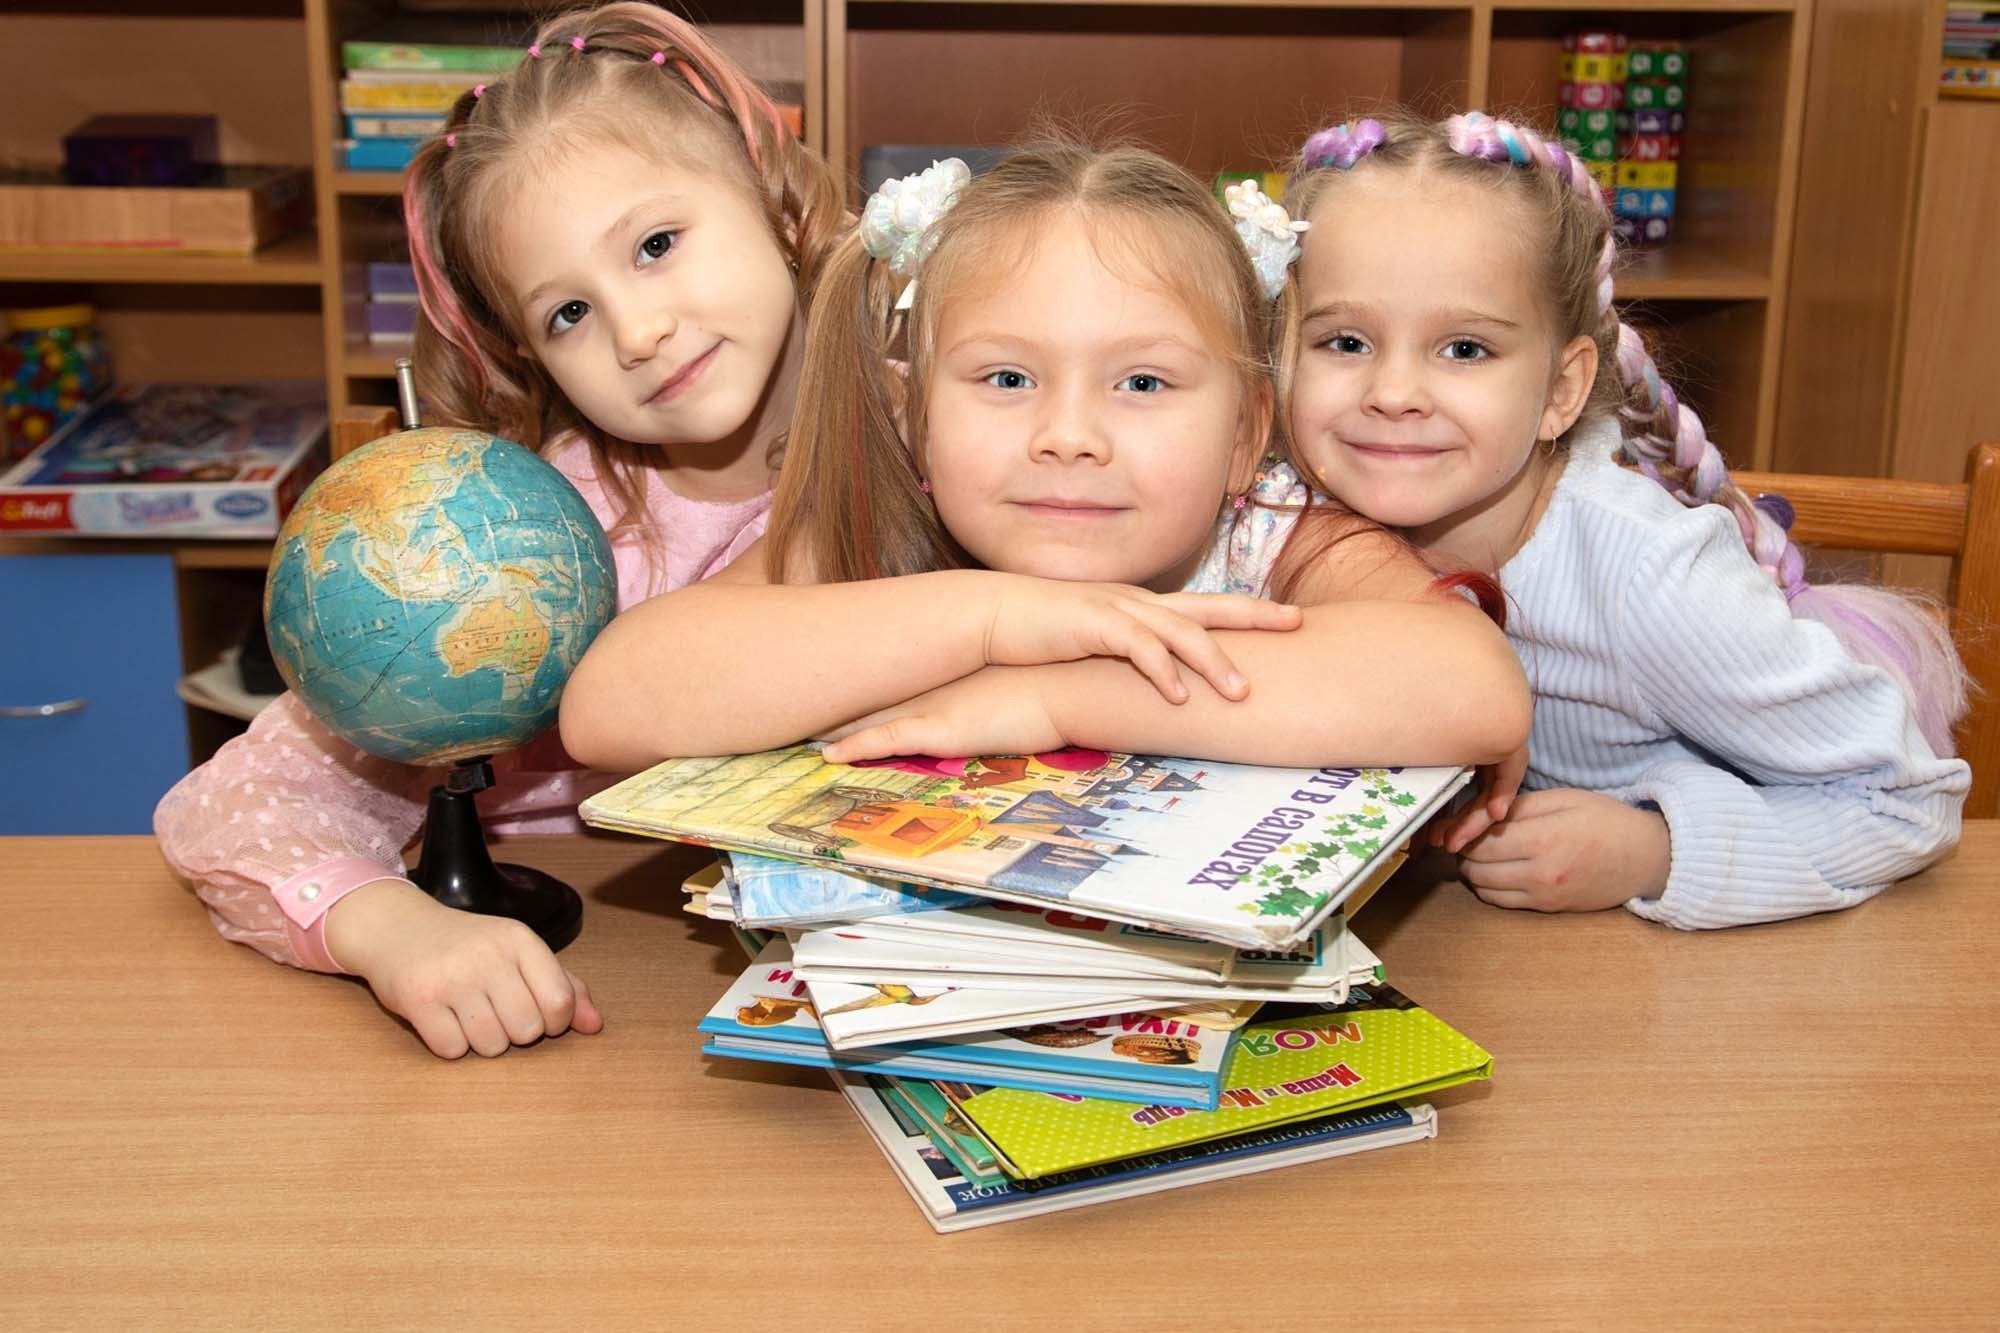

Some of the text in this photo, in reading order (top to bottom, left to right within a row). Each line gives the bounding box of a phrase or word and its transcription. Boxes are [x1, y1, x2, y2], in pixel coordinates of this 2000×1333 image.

[1187, 806, 1315, 891] сапогах
[1241, 1023, 1362, 1056] МОЯ
[1282, 1063, 1362, 1097] Маша
